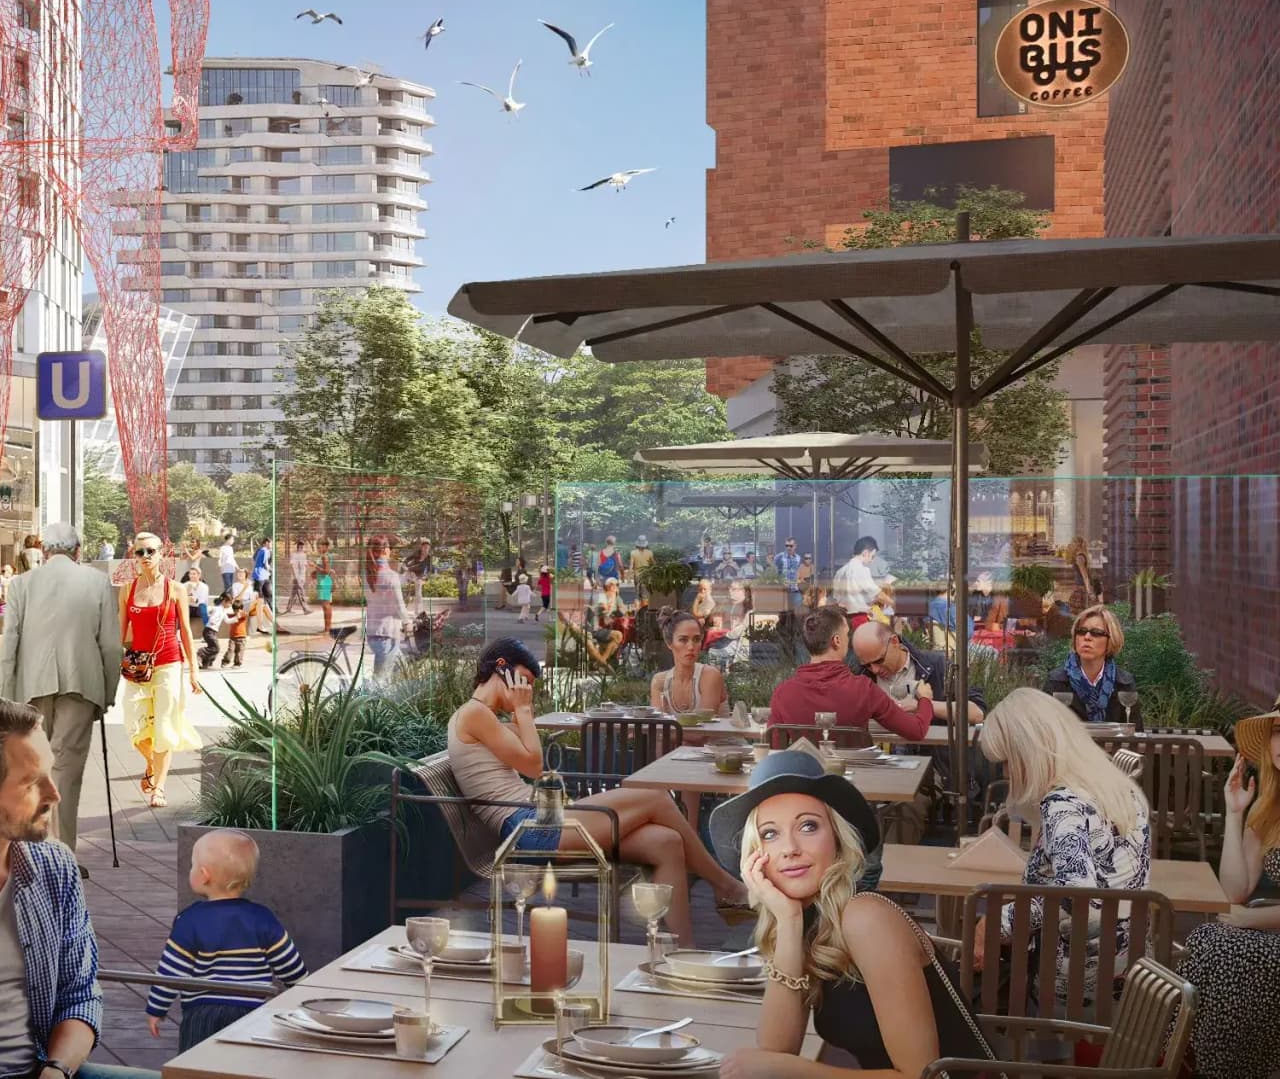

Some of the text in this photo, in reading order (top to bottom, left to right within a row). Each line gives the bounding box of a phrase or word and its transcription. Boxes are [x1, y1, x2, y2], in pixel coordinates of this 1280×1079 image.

[1020, 6, 1102, 42] ONI
[1019, 38, 1102, 86] BUS
[1030, 86, 1093, 101] COFFEE
[51, 361, 90, 409] U
